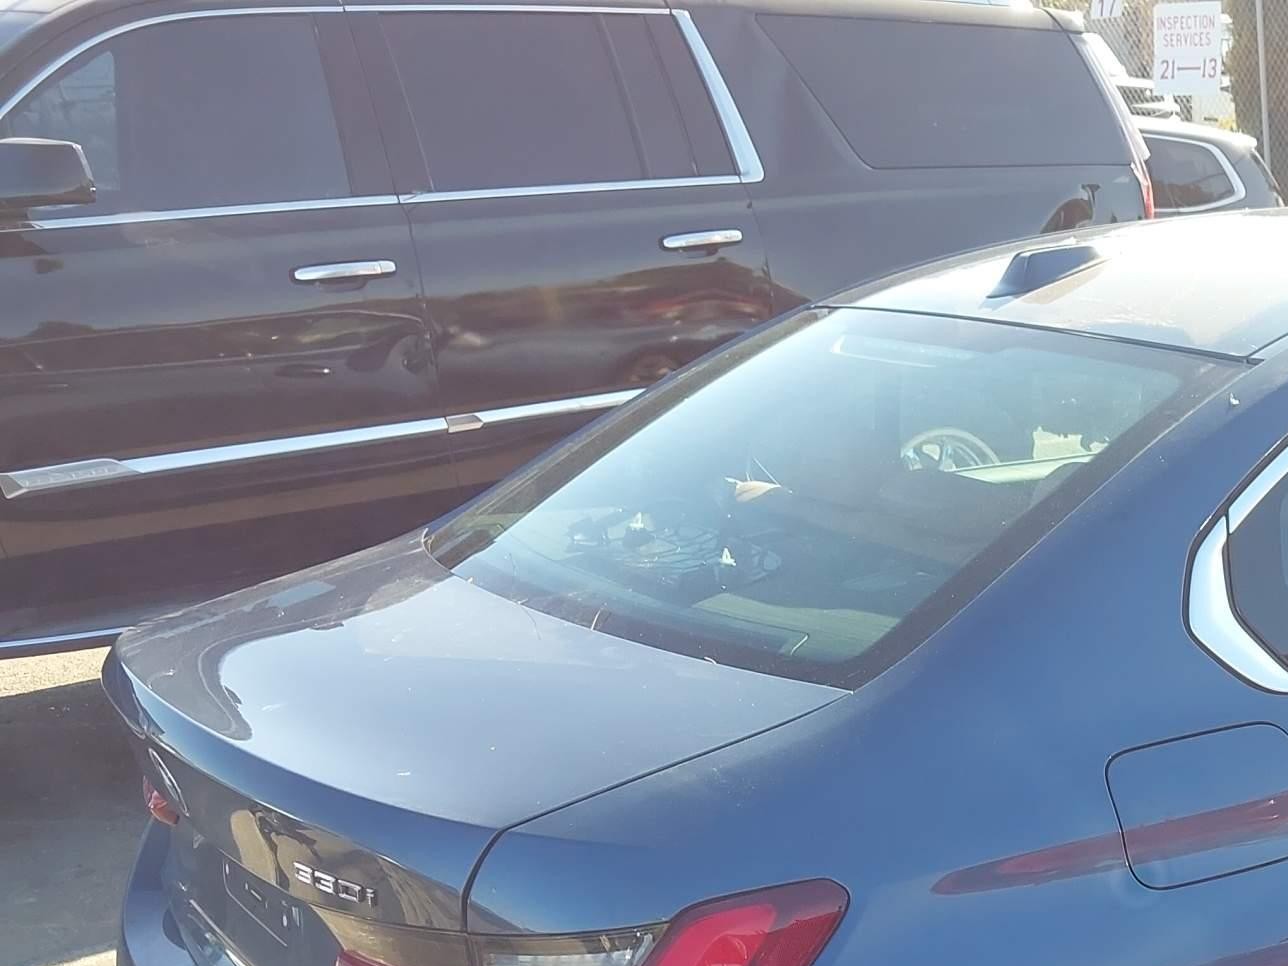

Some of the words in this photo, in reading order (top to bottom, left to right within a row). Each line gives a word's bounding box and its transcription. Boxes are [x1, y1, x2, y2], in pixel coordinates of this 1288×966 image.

[1157, 14, 1215, 31] INSPECTION
[1163, 32, 1211, 48] SERVICES
[293, 861, 375, 907] 330i
